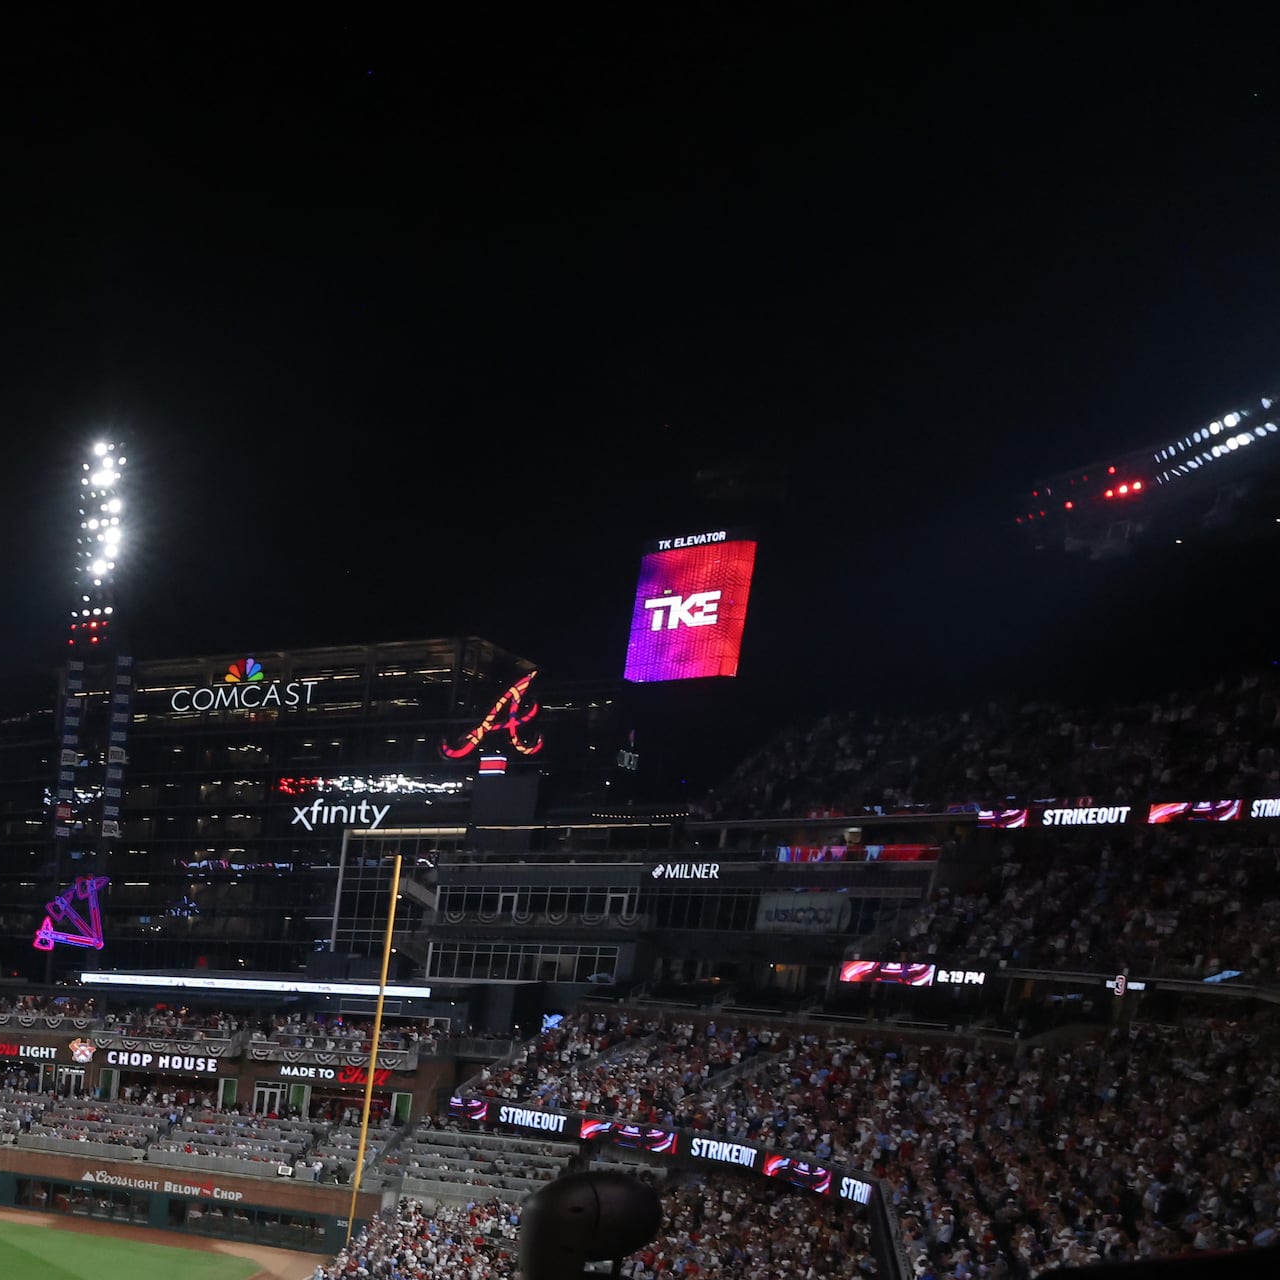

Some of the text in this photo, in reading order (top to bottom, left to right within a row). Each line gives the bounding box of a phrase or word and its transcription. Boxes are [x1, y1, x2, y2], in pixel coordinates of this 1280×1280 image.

[658, 531, 727, 550] TK ELEVATOR
[644, 590, 722, 631] TKE
[171, 681, 319, 712] COMCAST
[291, 798, 390, 831] xfinity
[1042, 807, 1130, 826] STRIKEOUT
[665, 863, 720, 879] MILNER
[965, 972, 985, 985] PM
[19, 1045, 57, 1059] LIGHT
[107, 1051, 218, 1072] CHOP HOUSE
[280, 1065, 316, 1078] MADE
[319, 1068, 335, 1079] TO
[499, 1106, 567, 1133] STRIKEOUT
[690, 1138, 757, 1169] STRIKEOUT
[95, 1170, 128, 1186] Coors
[128, 1179, 158, 1191] LIGHT
[213, 1188, 243, 1201] CHOP
